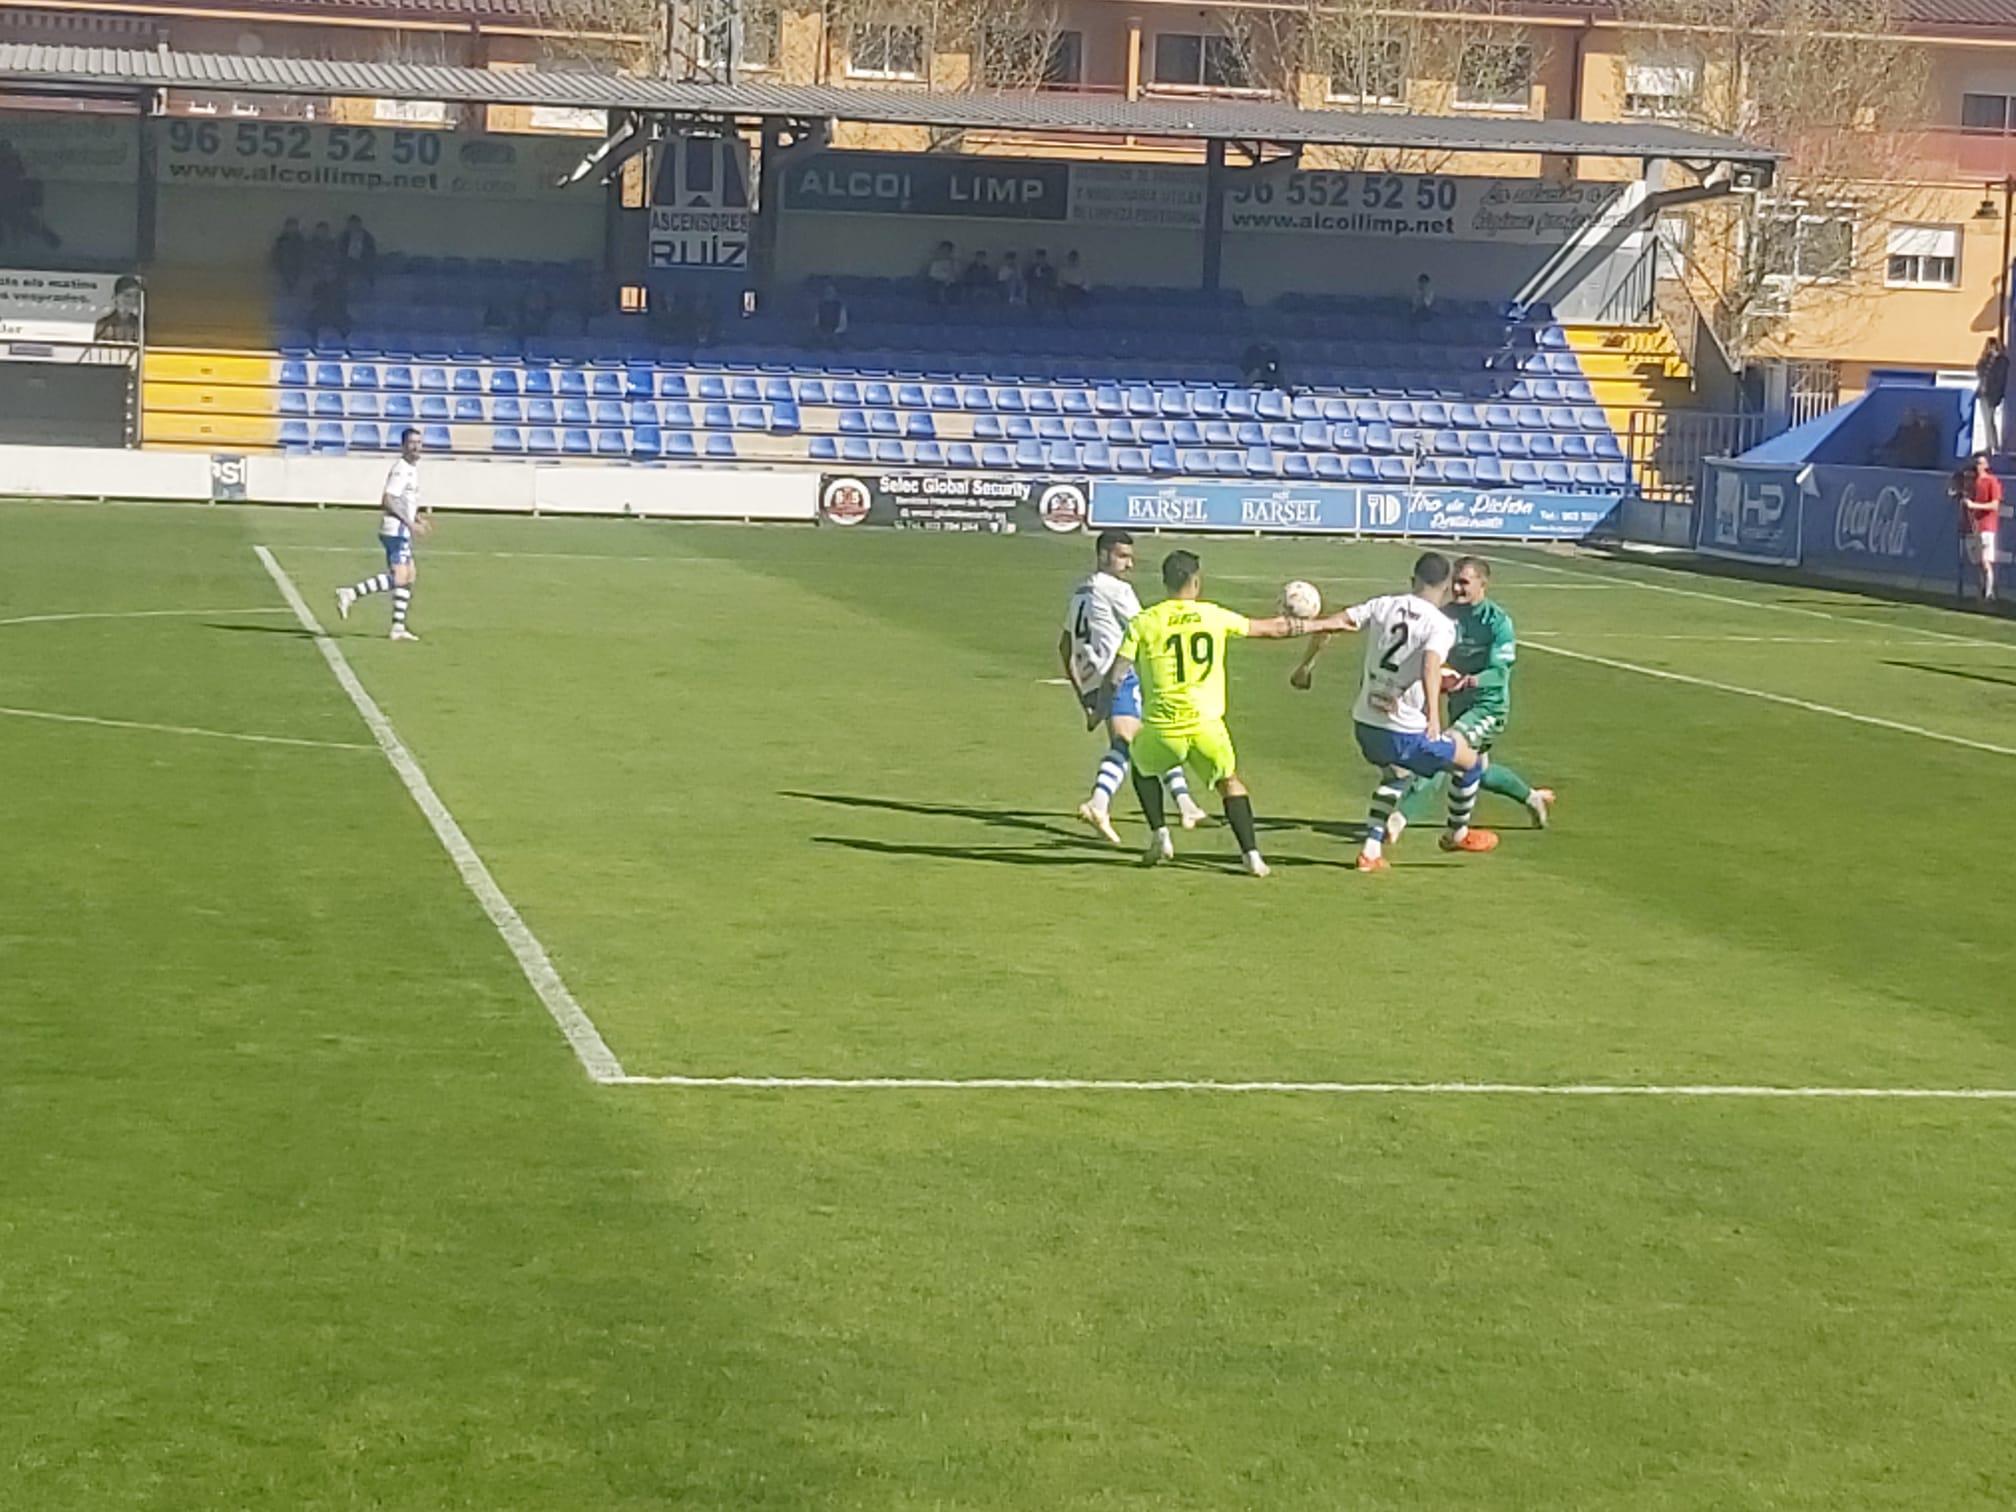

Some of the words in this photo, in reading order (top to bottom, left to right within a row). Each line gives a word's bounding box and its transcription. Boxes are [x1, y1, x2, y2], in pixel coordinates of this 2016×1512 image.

[168, 121, 221, 155] 96
[235, 123, 311, 160] 552
[326, 127, 376, 161] 52
[391, 131, 441, 166] 50
[949, 174, 1043, 204] LIMP
[1288, 174, 1350, 207] 552
[1363, 177, 1404, 209] 52
[1417, 179, 1457, 211] 50
[652, 211, 748, 233] ASCENSORES
[922, 478, 968, 496] Global
[972, 480, 1031, 501] Security
[1127, 499, 1207, 523] BARSEL
[1241, 502, 1320, 526] BARSEL
[1075, 600, 1092, 644] 4
[1165, 632, 1213, 683] 19
[1379, 622, 1409, 672] 2
